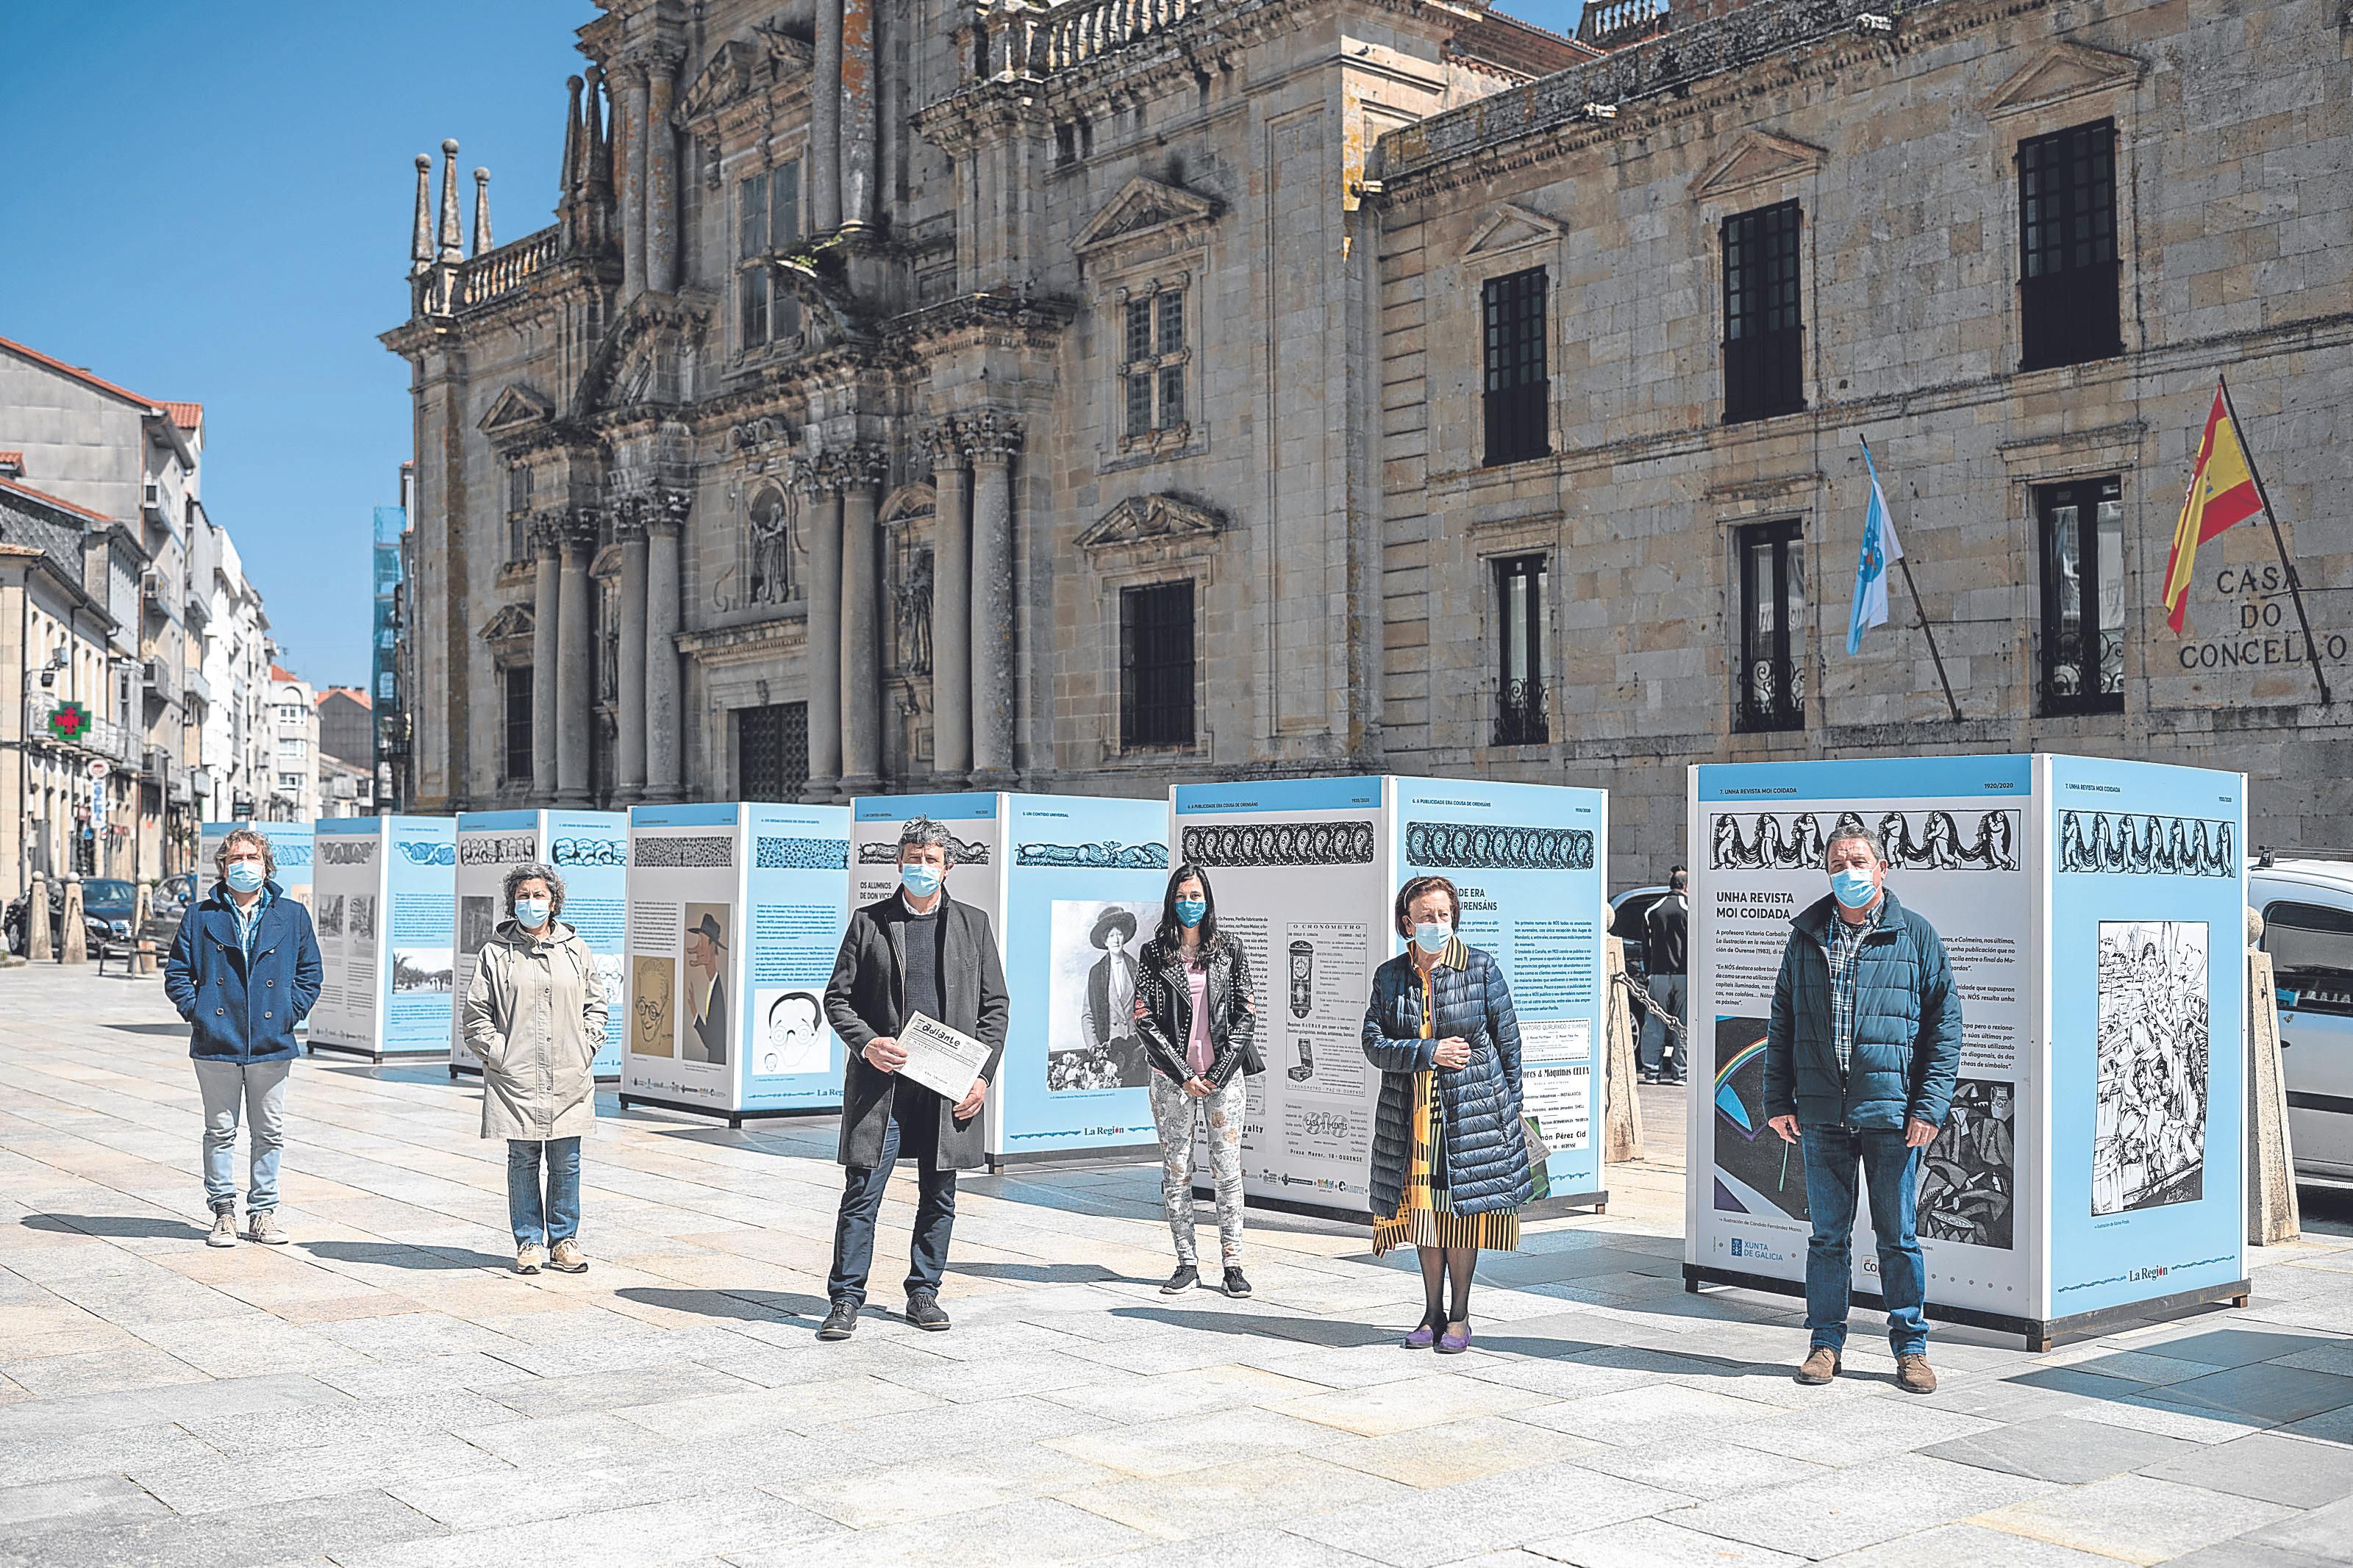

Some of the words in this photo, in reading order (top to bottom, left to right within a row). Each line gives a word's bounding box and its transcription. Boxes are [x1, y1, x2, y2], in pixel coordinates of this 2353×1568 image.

[2217, 565, 2302, 594] CASA
[2241, 604, 2281, 629] DO
[1471, 889, 1485, 897] ERA
[1716, 892, 1747, 902] UNHA
[1750, 892, 1794, 903] REVISTA
[1716, 908, 1737, 917] MOI
[1740, 909, 1790, 919] COIDADA
[1544, 1069, 1571, 1078] Máquinas
[1574, 1067, 1589, 1075] CELTA
[1332, 1122, 1347, 1130] LENTES
[1744, 1241, 1768, 1251] XUNTA
[1755, 1251, 1782, 1261] GALICIA
[2129, 1270, 2140, 1281] La
